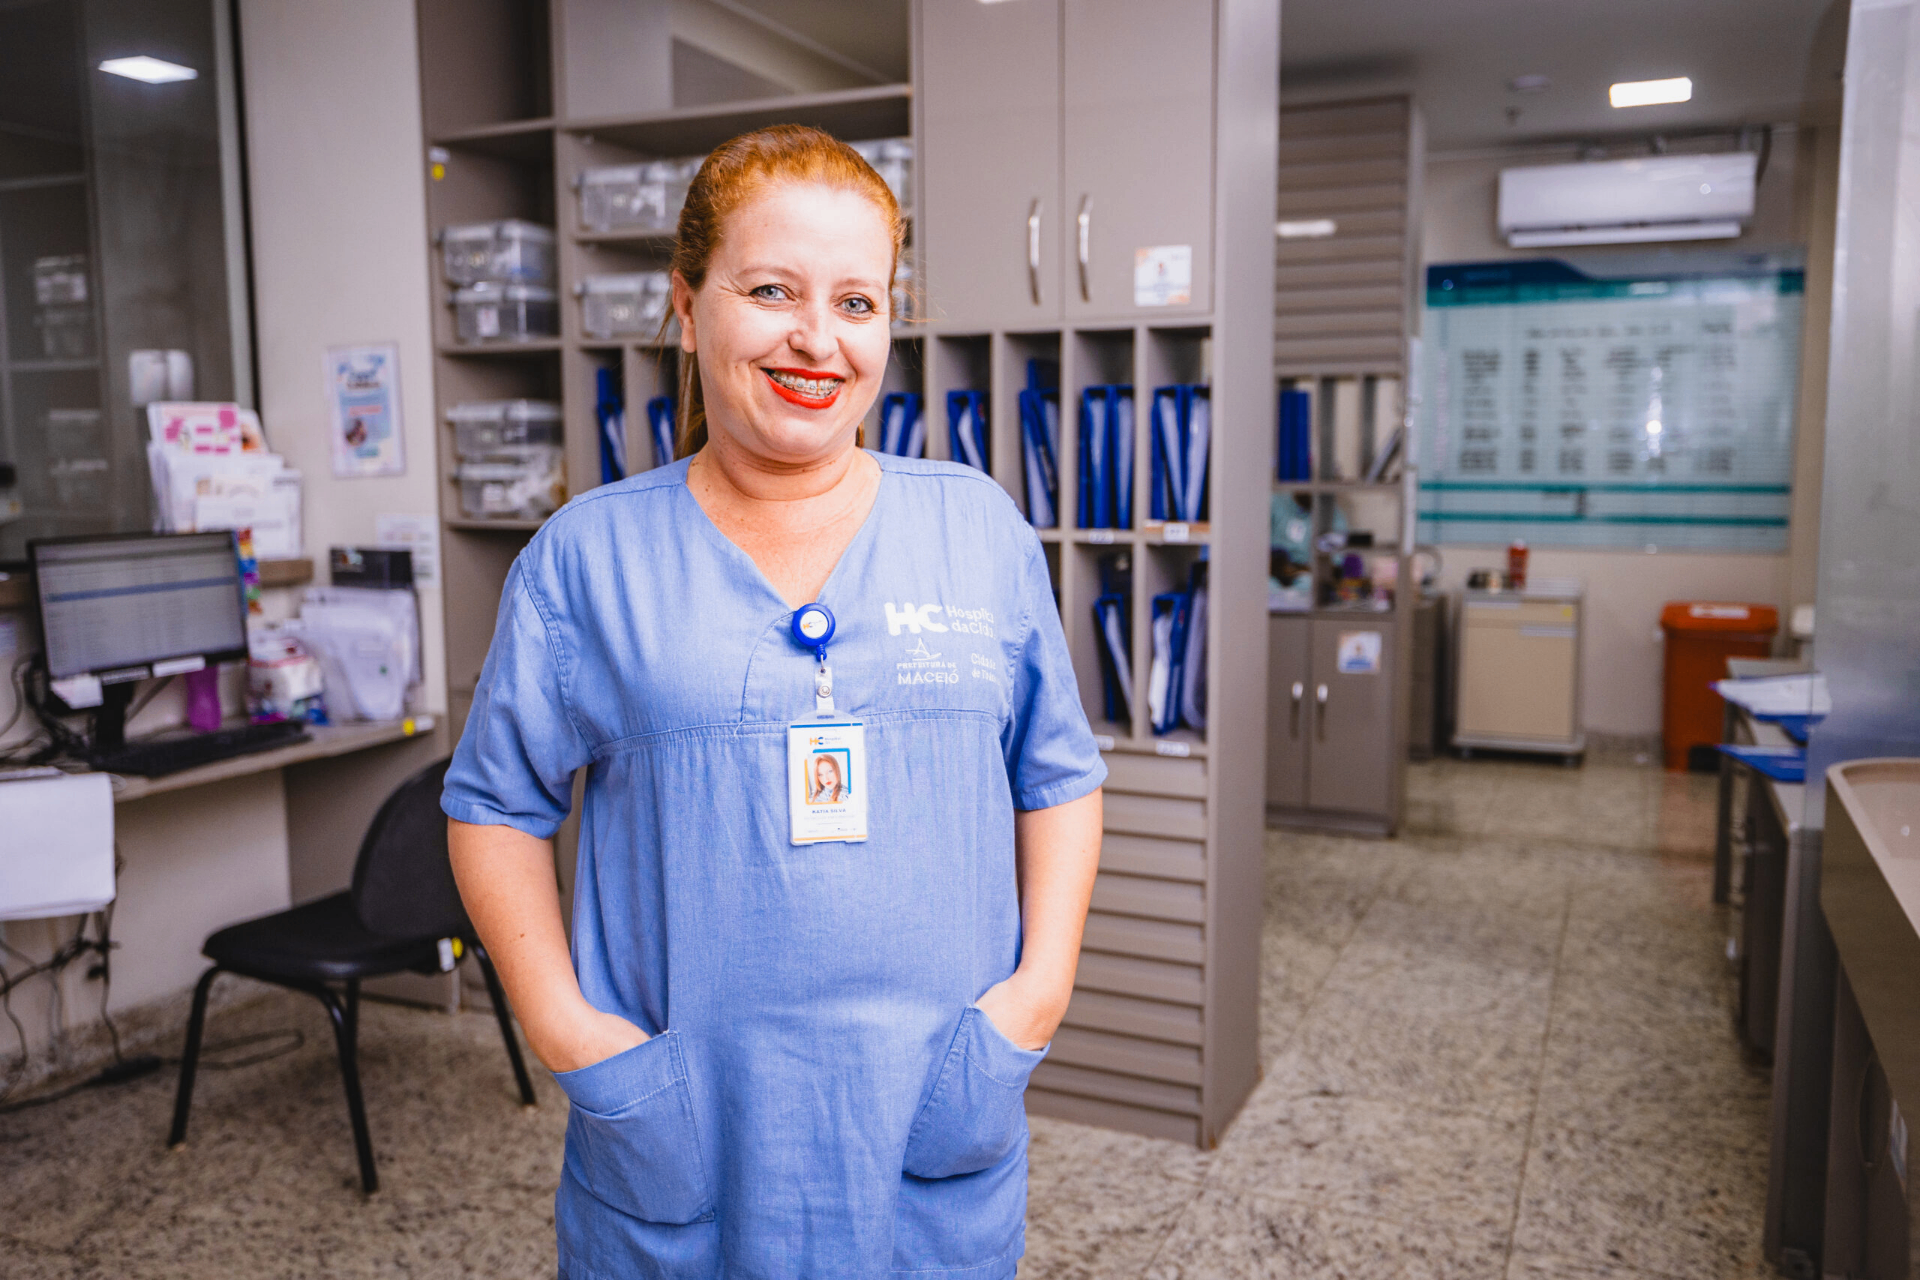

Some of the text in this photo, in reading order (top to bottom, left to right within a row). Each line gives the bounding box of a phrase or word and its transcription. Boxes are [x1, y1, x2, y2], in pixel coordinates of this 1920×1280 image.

[884, 602, 949, 636] HC
[946, 605, 994, 624] Hospita
[896, 661, 946, 670] PREFEITURA
[898, 668, 959, 685] MACEIÓ
